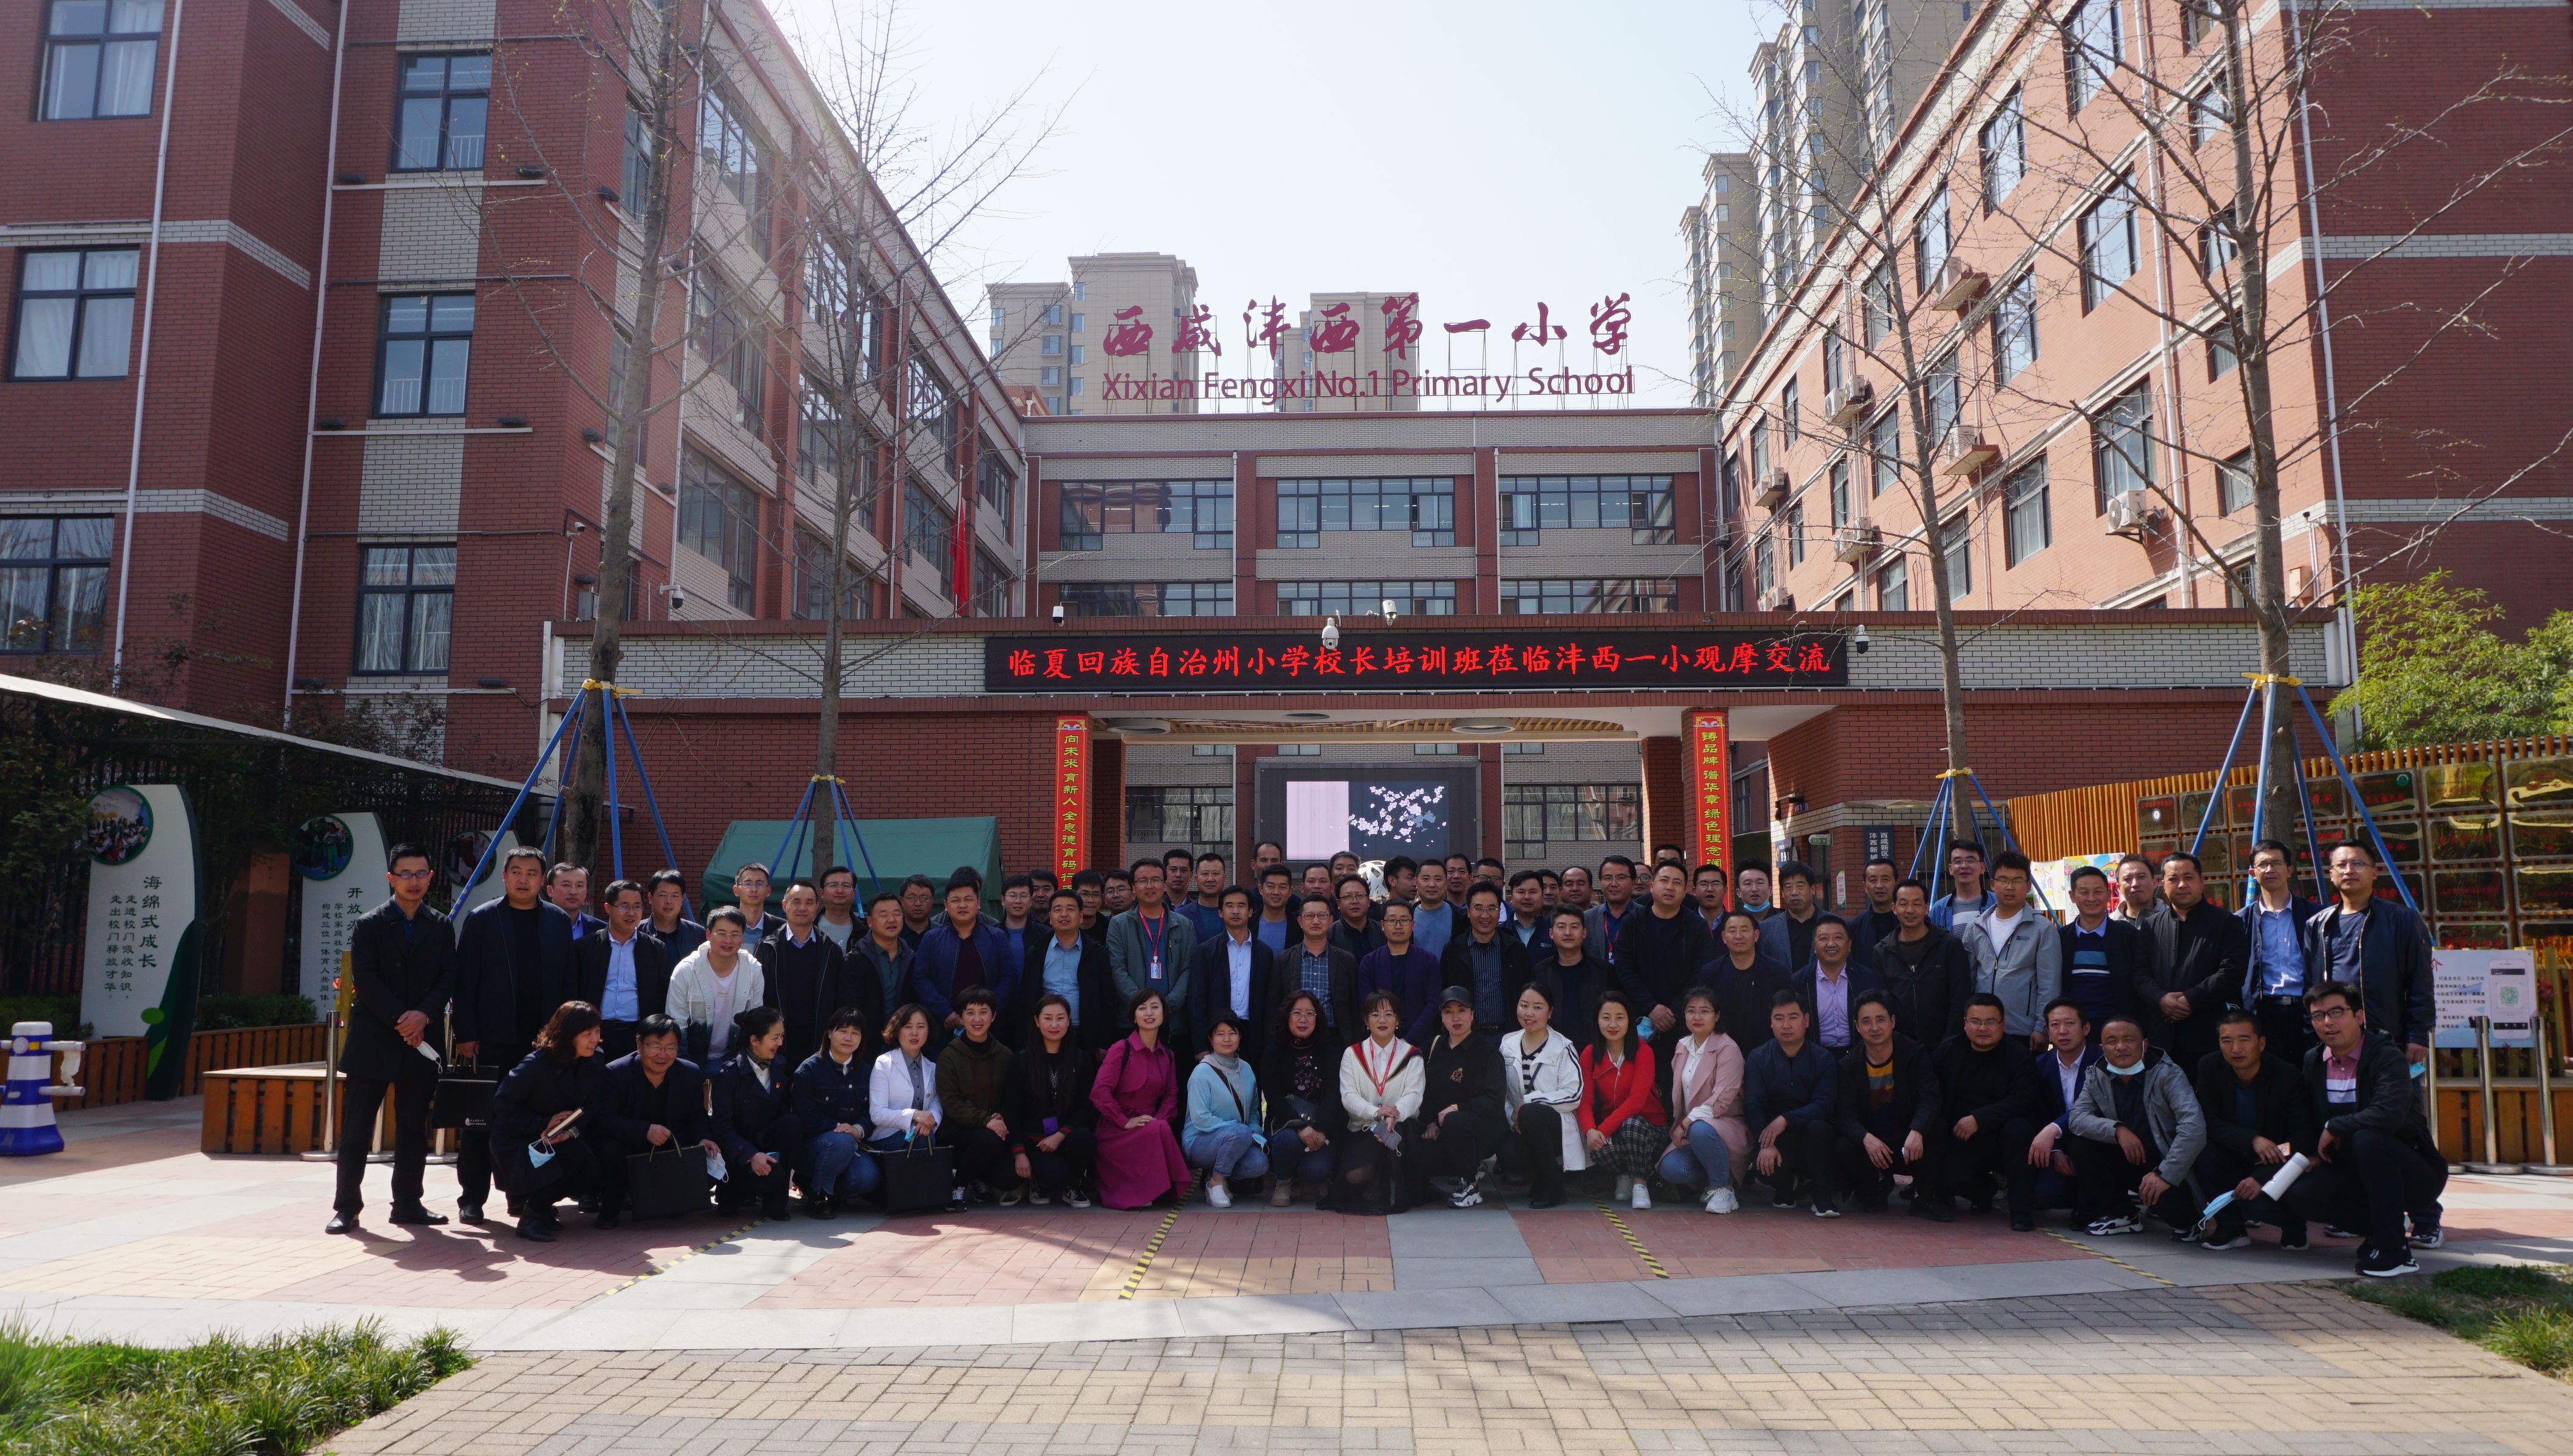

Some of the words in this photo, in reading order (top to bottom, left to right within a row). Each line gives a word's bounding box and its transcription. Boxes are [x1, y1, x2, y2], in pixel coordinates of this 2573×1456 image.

[1102, 292, 1632, 361] 西咸沣西第一小学
[1102, 371, 1194, 400] Xixian
[1204, 369, 1306, 406] Fengxi
[1316, 369, 1379, 398] No.1
[1391, 368, 1511, 403] Primary
[1529, 365, 1635, 396] School
[1009, 642, 1830, 679] 临夏回族自治州小学校长培训班莅临沣西一小观摩交流
[137, 875, 163, 969] 海绵式成长
